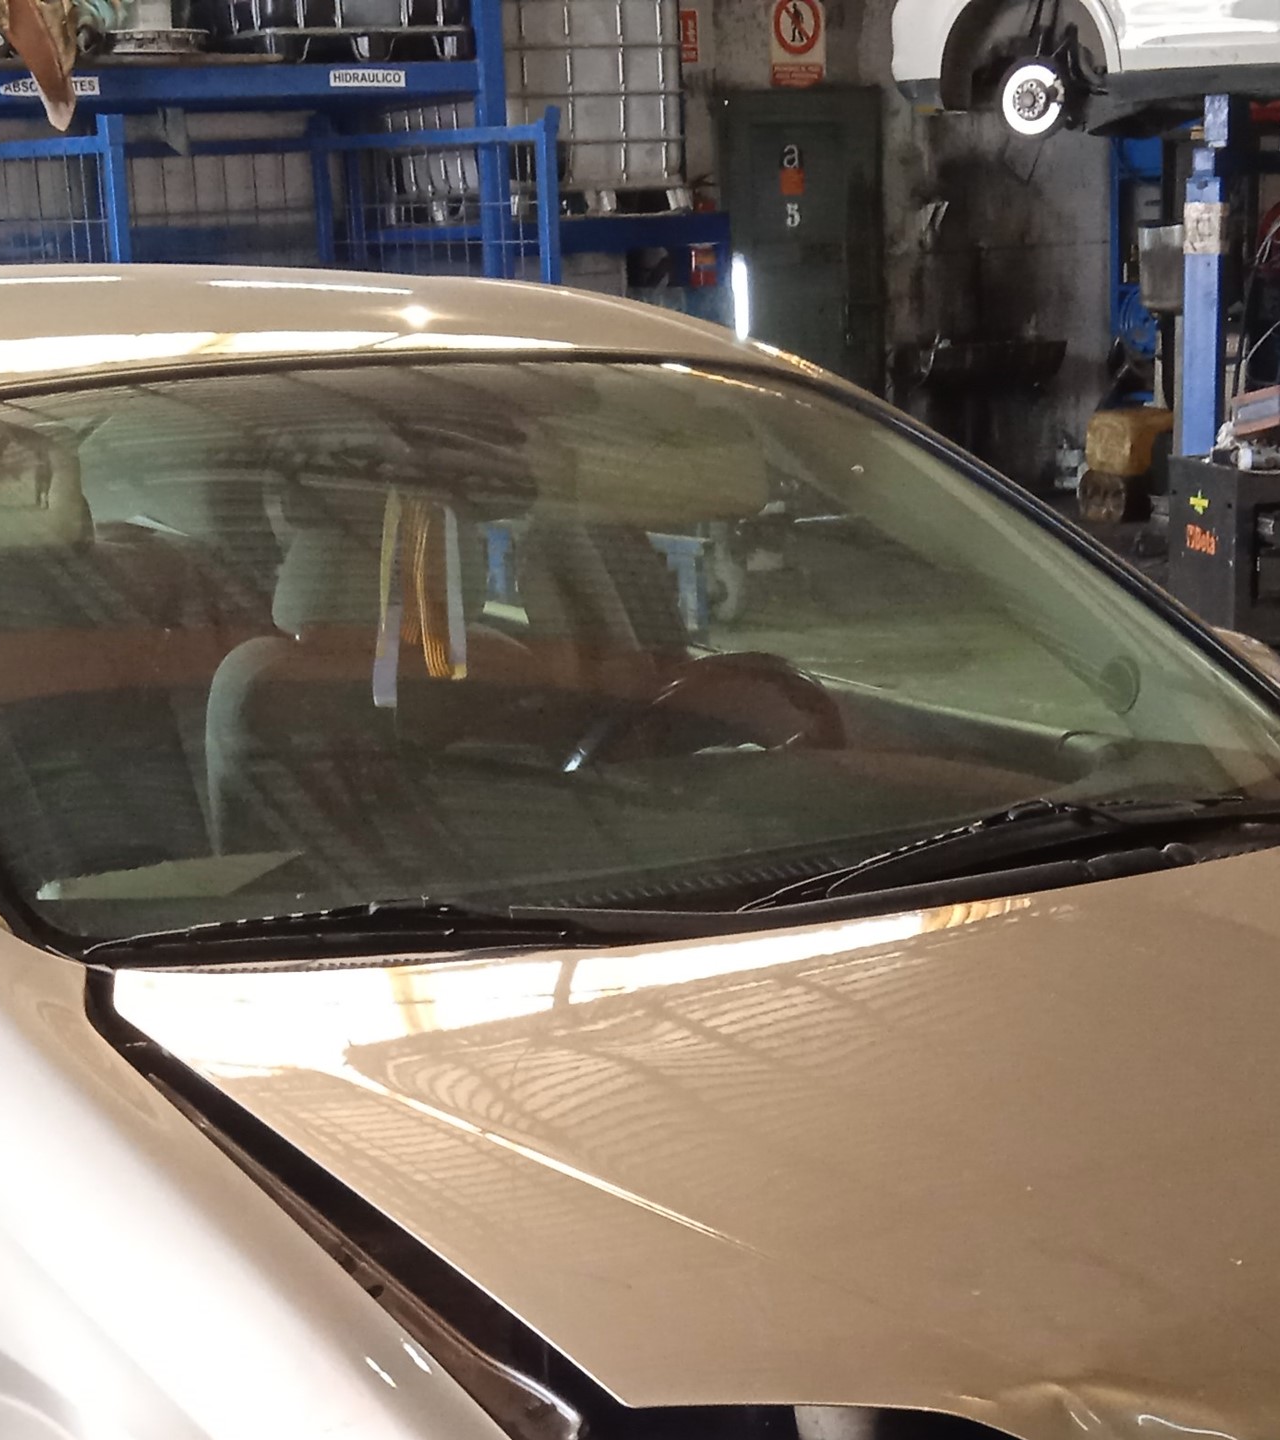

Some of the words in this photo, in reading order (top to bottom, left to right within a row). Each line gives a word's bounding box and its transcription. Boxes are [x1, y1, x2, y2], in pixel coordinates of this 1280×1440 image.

[333, 72, 402, 83] HIDRAULICO
[4, 80, 95, 93] ABSOTES
[786, 202, 801, 228] 5
